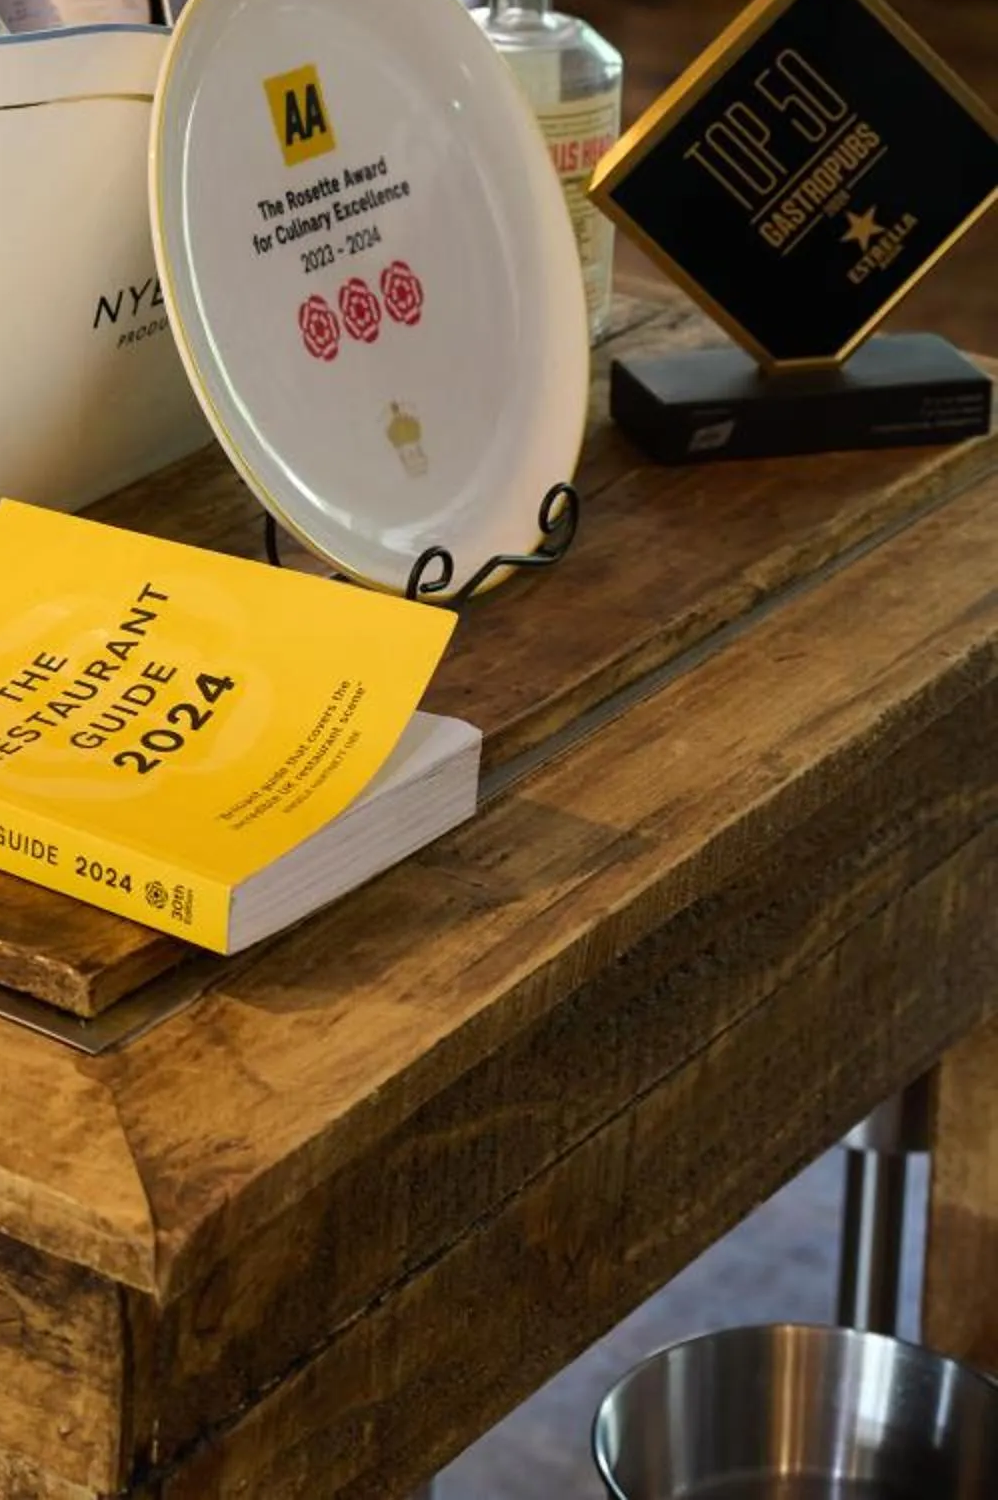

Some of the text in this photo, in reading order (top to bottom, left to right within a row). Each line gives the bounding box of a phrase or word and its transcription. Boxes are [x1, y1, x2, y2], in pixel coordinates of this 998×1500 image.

[285, 84, 326, 147] AA
[683, 49, 848, 211] TOP 50
[252, 181, 410, 255] for Culinary Excellence
[258, 155, 388, 221] The Rosette Award
[758, 121, 881, 248] GASTROPUBS
[301, 243, 335, 274] 2023
[346, 225, 382, 255] 2024
[70, 661, 178, 749] GUIDE
[113, 673, 235, 774] 2024
[307, 704, 337, 743] covers
[332, 680, 351, 701] the
[75, 855, 132, 893] 2024
